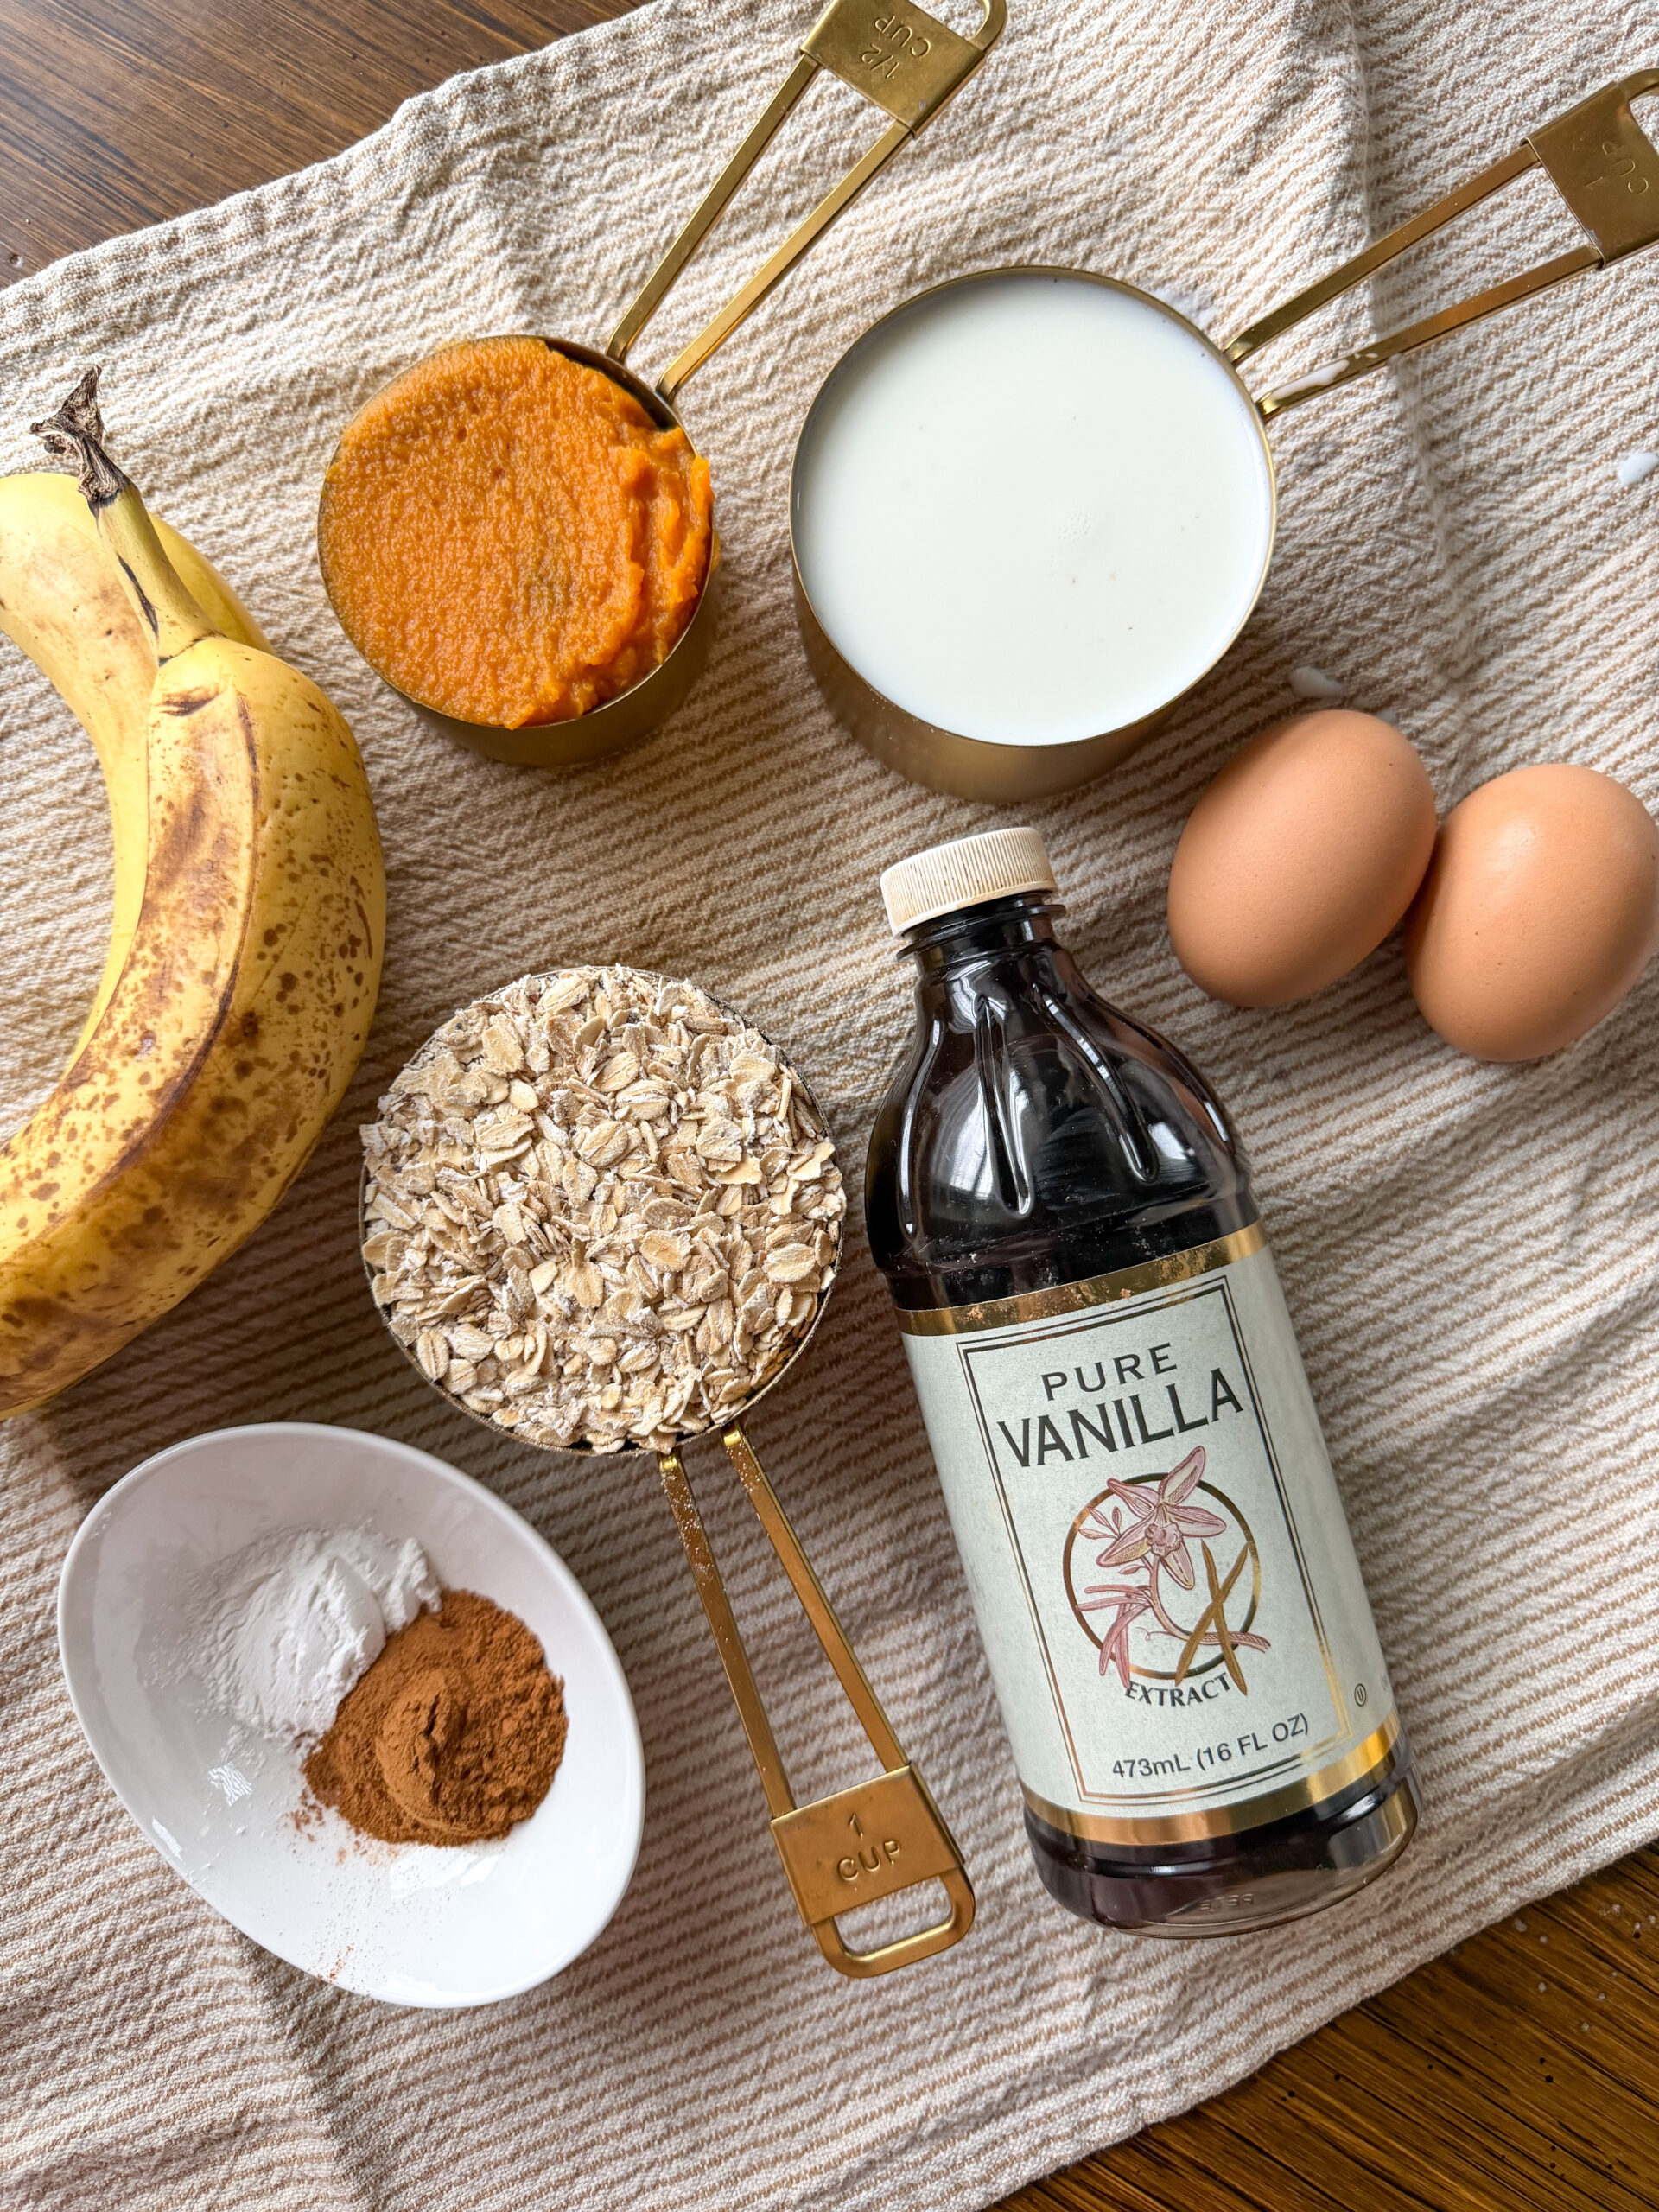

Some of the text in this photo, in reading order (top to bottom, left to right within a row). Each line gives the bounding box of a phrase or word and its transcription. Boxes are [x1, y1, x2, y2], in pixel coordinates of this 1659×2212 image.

[874, 15, 931, 58] CUP
[861, 43, 899, 79] 1/2
[1602, 141, 1649, 194] CUP
[1040, 1342, 1177, 1401] PURE
[996, 1367, 1244, 1467] VANILLA
[1125, 1671, 1230, 1707] EXTRACT
[1112, 1712, 1309, 1778] 473mL (16 FL OZ)
[847, 1813, 863, 1840] 1
[836, 1840, 901, 1882] CUP
